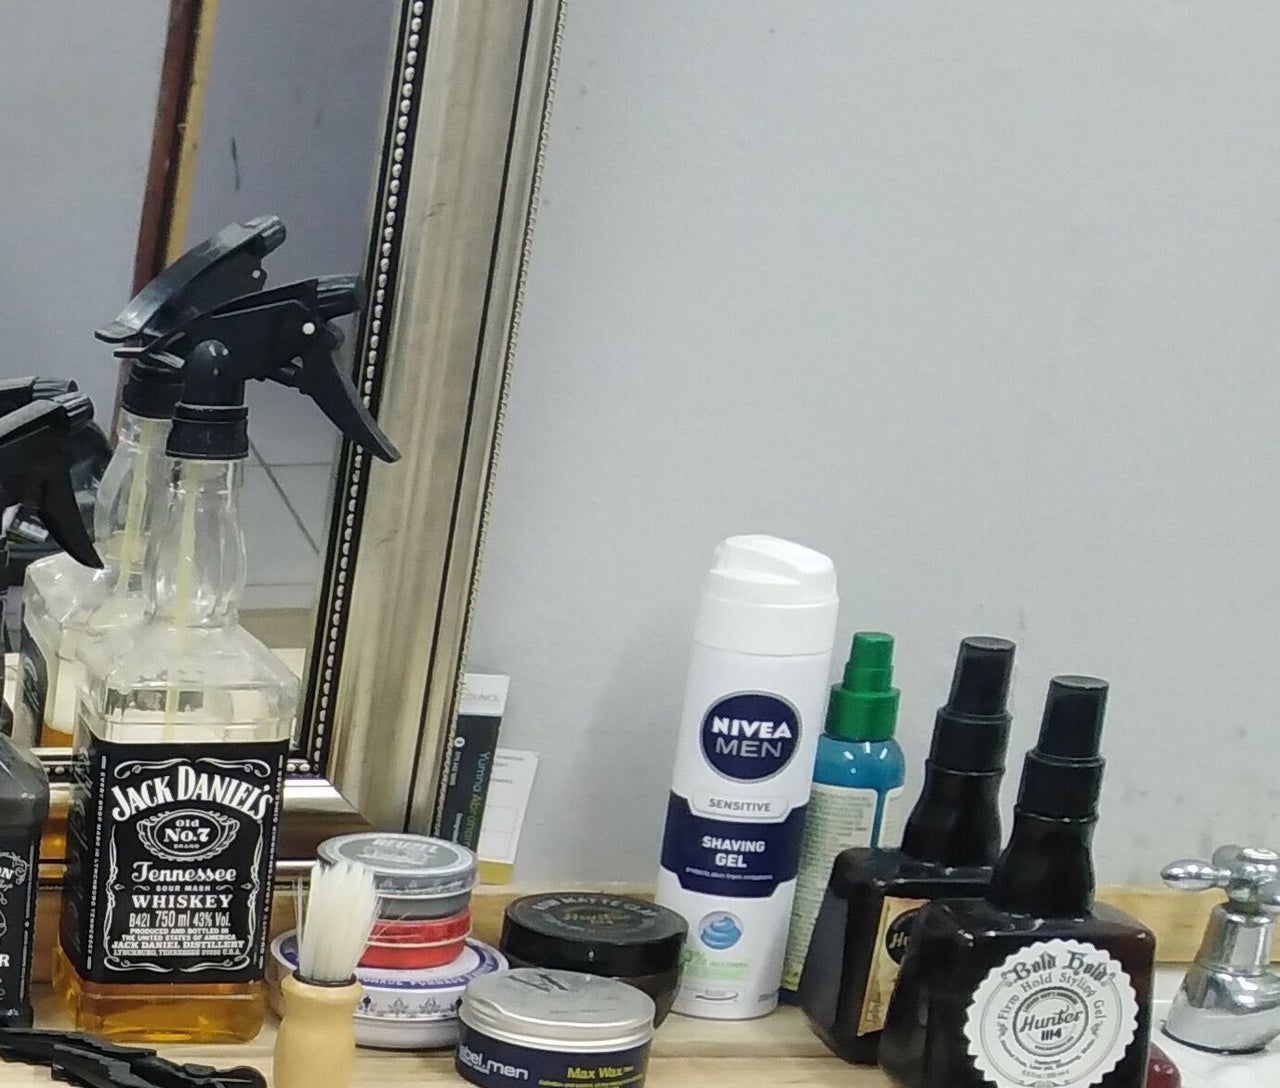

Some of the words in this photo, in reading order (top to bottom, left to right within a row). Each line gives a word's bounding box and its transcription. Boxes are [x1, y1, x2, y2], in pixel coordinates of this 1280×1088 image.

[711, 716, 793, 739] NIVEA
[715, 736, 782, 758] MEN
[111, 775, 175, 822] JACK
[176, 765, 274, 820] DANIEL'S
[708, 798, 771, 813] SENSITIVE
[175, 818, 200, 827] Old
[702, 835, 766, 853] SHAVING
[715, 853, 747, 868] GEL
[131, 861, 237, 883] Tennessee
[131, 894, 234, 909] WHISKEY
[155, 910, 176, 928] 750
[177, 910, 190, 928] ml
[192, 911, 213, 928] 43%
[214, 912, 232, 927] Vol.
[111, 941, 139, 949] JACK
[140, 941, 181, 949] DANIEL
[182, 940, 245, 948] DISTILLERY
[1008, 951, 1057, 983] Bold
[1020, 972, 1053, 993] Hold
[1093, 999, 1107, 1020] Gel
[1019, 1005, 1084, 1033] Hunter
[566, 1066, 596, 1079] Max
